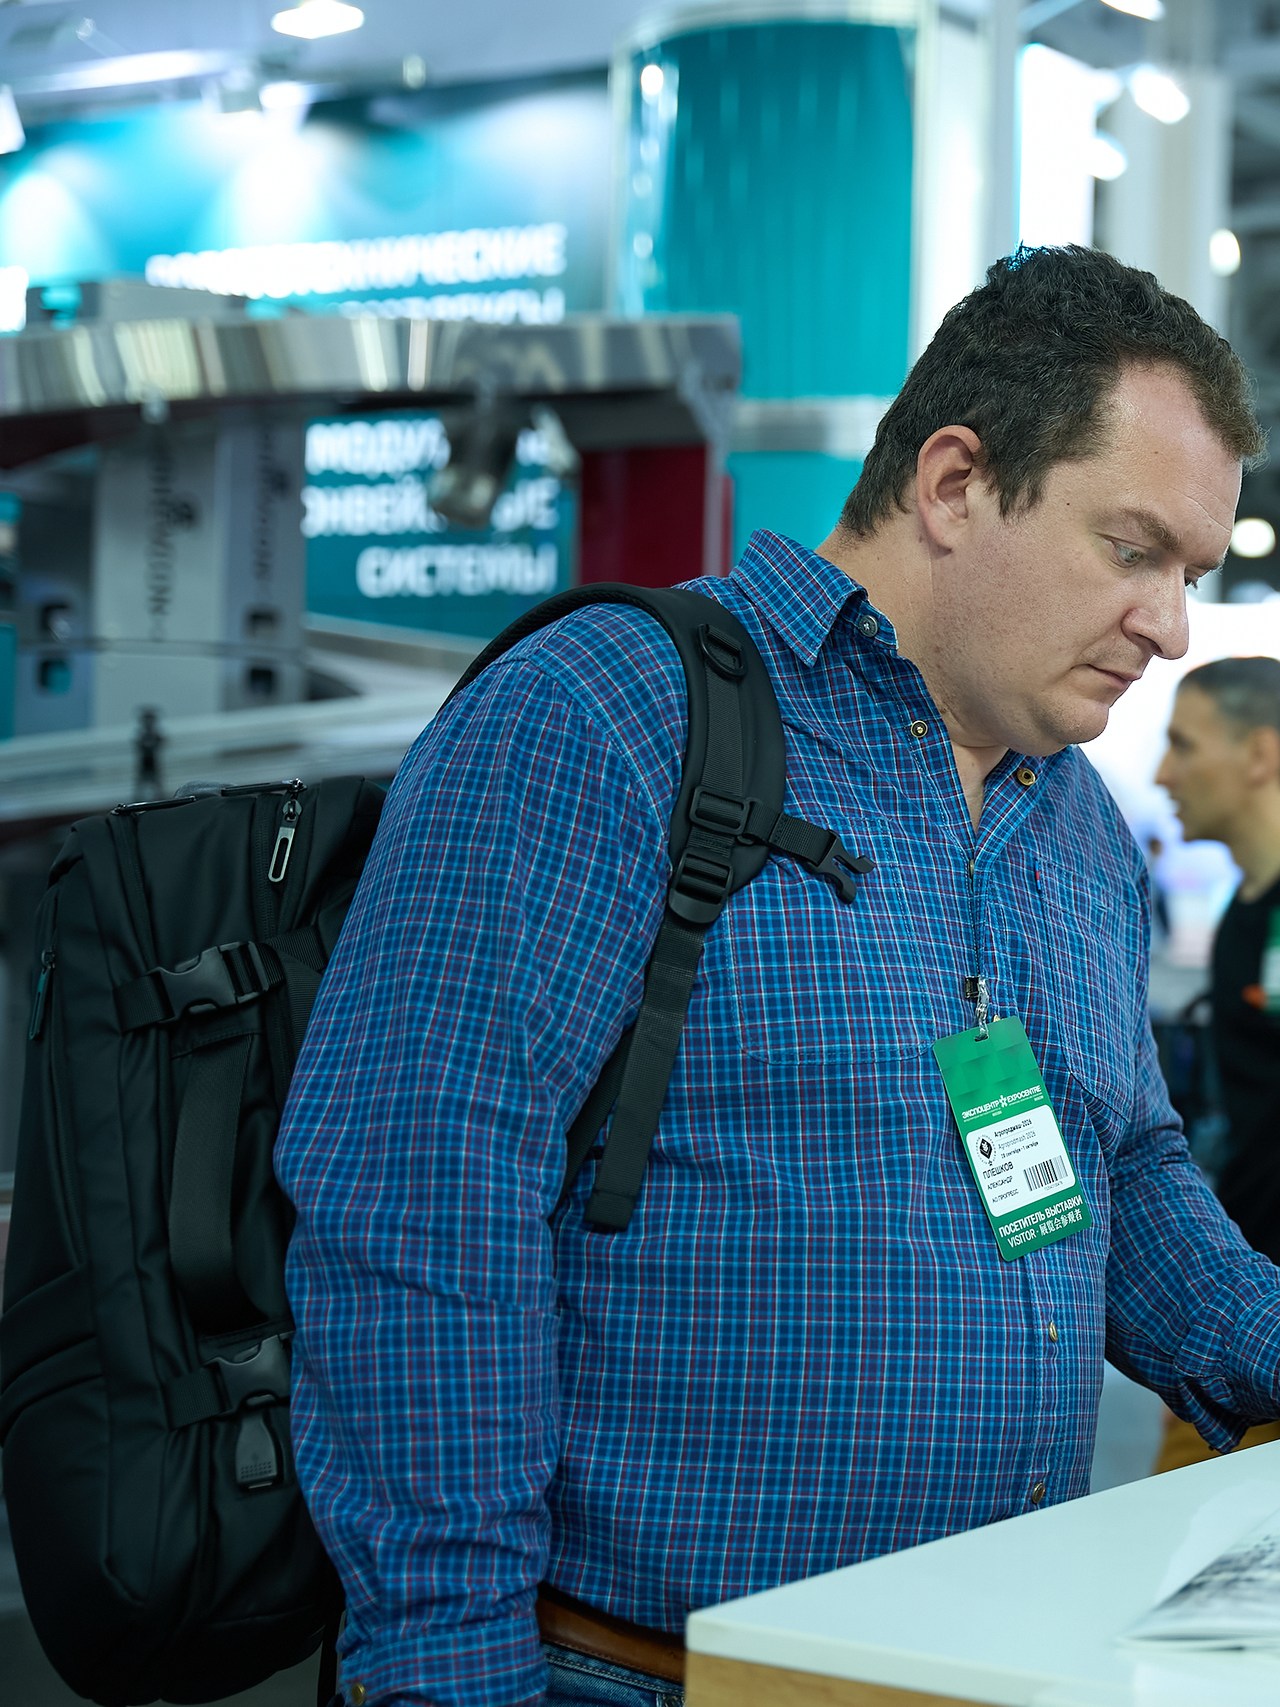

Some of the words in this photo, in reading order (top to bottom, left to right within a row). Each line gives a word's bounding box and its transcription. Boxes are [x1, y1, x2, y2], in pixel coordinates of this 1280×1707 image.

[356, 543, 558, 598] СИСТЕМЫ
[1007, 1085, 1042, 1103] EXPOCENTRE
[962, 1099, 999, 1119] ЭКСПОЦЕНТР
[983, 1161, 1014, 1180] ПЛЕШКОВ
[987, 1175, 1013, 1190] АЛЕКСАНДР
[998, 1211, 1046, 1238] ПОСЕТИТЕЛЬ
[1044, 1194, 1083, 1218] ВЫСТАВКИ
[1007, 1228, 1037, 1248] VISITOR
[1039, 1208, 1083, 1236] 展览会参观者
